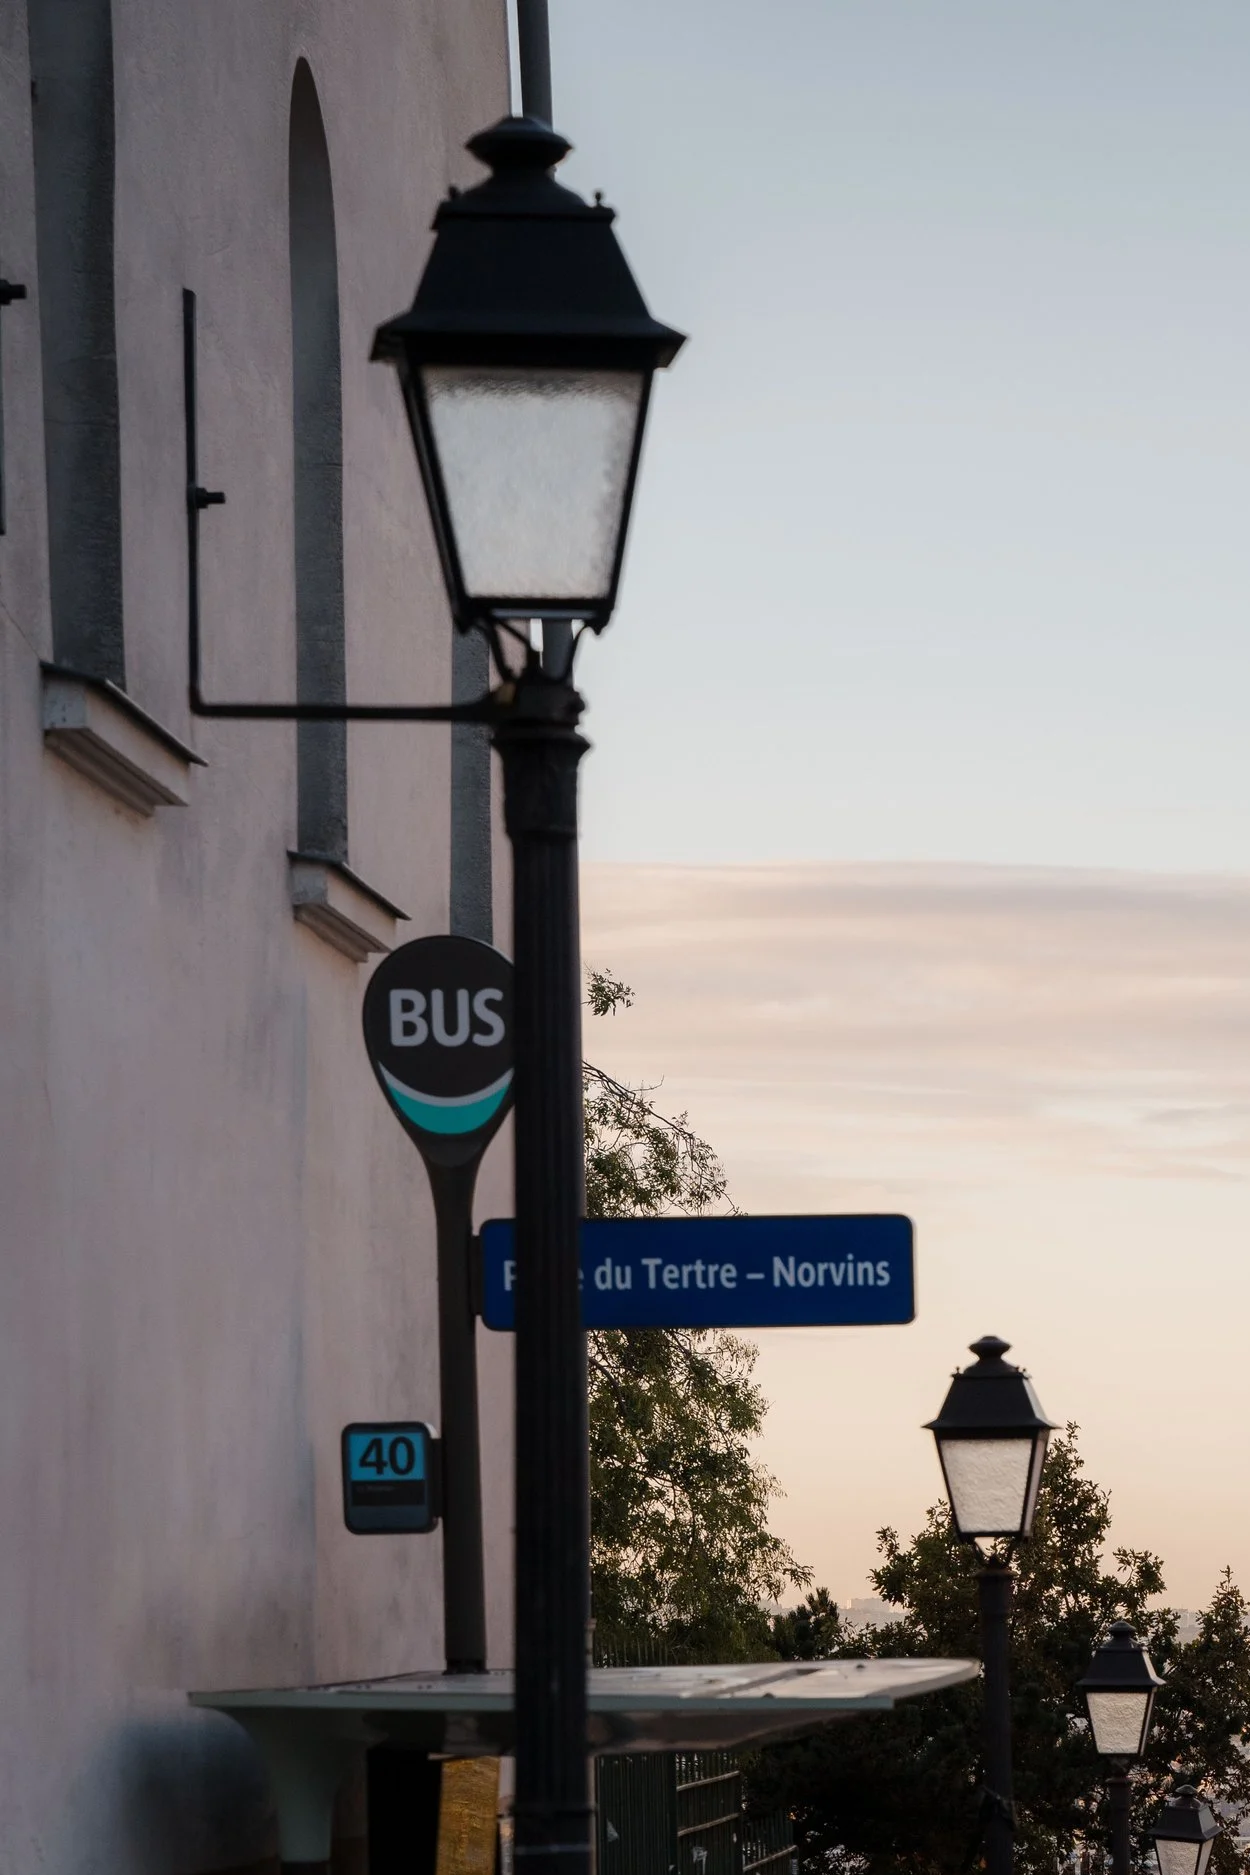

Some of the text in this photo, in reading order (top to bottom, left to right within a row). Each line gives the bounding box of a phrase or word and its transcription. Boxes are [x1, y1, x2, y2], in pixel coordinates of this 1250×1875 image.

[389, 987, 506, 1047] BUS
[594, 1257, 632, 1290] du
[641, 1257, 737, 1289] Tertre
[772, 1253, 891, 1288] Norvins
[358, 1435, 416, 1476] 40
